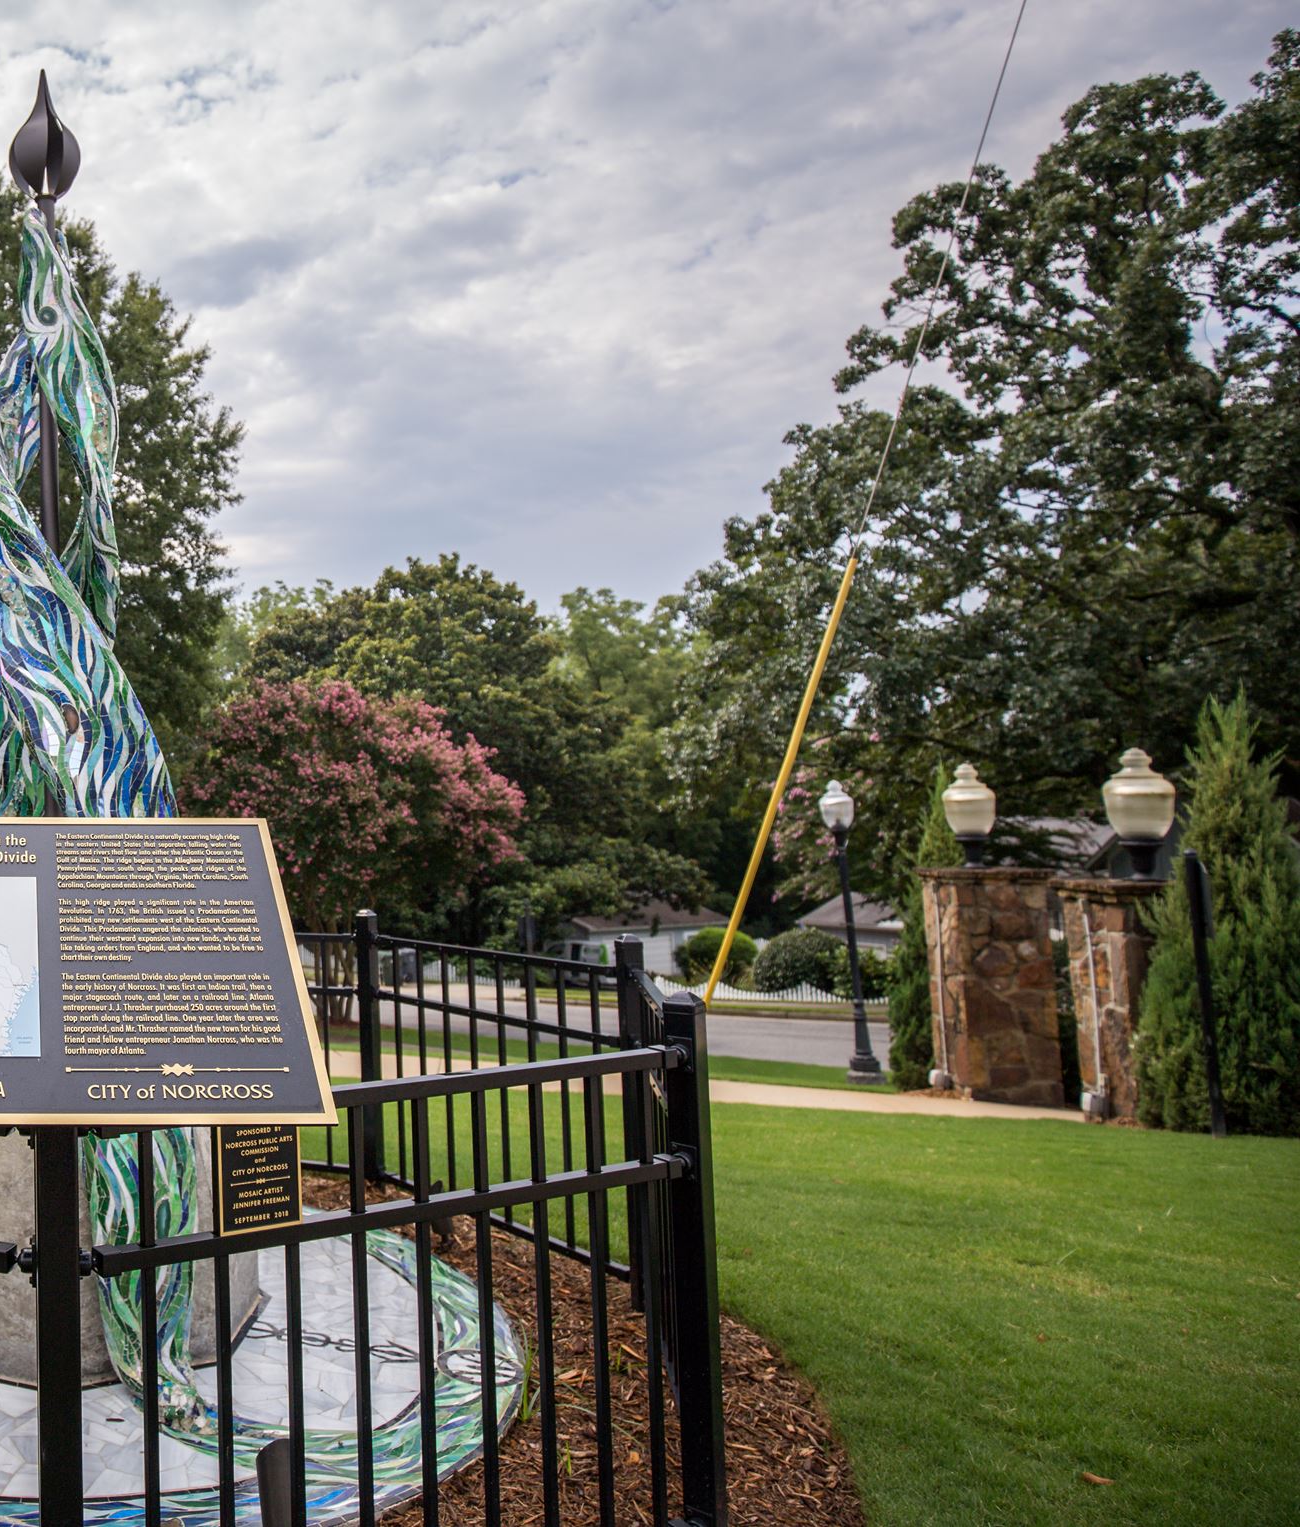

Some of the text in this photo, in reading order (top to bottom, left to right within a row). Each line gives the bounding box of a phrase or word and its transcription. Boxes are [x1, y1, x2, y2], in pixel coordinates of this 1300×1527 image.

[5, 834, 27, 846] the
[61, 944, 72, 952] like
[75, 944, 95, 954] taking
[98, 944, 117, 952] orders
[120, 944, 135, 952] from
[168, 944, 180, 952] and
[183, 944, 196, 952] who
[198, 944, 221, 952] wanted
[232, 944, 240, 952] be
[242, 944, 255, 952] free
[62, 973, 74, 981] The
[76, 973, 100, 981] Eastern
[102, 973, 139, 981] Continental
[142, 973, 162, 981] Divide
[165, 973, 178, 981] also
[180, 973, 201, 983] played
[214, 973, 246, 983] important
[248, 973, 261, 981] role
[263, 973, 269, 981] in
[62, 983, 72, 991] the
[75, 983, 91, 993] early
[94, 983, 116, 993] history
[119, 983, 125, 991] of
[128, 983, 158, 991] Norcross.
[160, 983, 165, 991] It
[182, 983, 195, 991] first
[208, 983, 229, 991] Indian
[232, 983, 248, 993] trail,
[250, 983, 265, 991] then
[63, 993, 82, 1003] major
[86, 993, 121, 1003] stagecoach
[125, 994, 144, 1003] route,
[148, 993, 160, 1001] and
[164, 993, 178, 1001] later
[202, 993, 228, 1001] railroad
[232, 993, 246, 1001] line.
[250, 993, 274, 1001] Atlanta
[63, 1005, 106, 1014] entrepreneur
[124, 1004, 152, 1012] Thrasher
[155, 1004, 189, 1014] purchased
[191, 1004, 204, 1012] 250
[224, 1004, 248, 1012] around
[250, 1004, 261, 1012] the
[263, 1004, 276, 1012] first
[64, 1015, 77, 1024] stop
[80, 1014, 98, 1022] north
[101, 1014, 120, 1024] along
[123, 1014, 133, 1022] the
[136, 1014, 163, 1022] railroad
[165, 1014, 180, 1022] line.
[183, 1014, 196, 1022] One
[199, 1016, 213, 1024] year
[216, 1014, 231, 1022] later
[234, 1014, 245, 1022] the
[64, 1025, 109, 1035] incorporated,
[111, 1025, 124, 1033] and
[126, 1025, 136, 1033] Mr.
[138, 1025, 167, 1033] Thrasher
[170, 1025, 193, 1033] named
[195, 1025, 206, 1033] the
[241, 1025, 250, 1033] for
[252, 1025, 262, 1033] his
[264, 1025, 280, 1035] good
[65, 1036, 85, 1044] friend
[87, 1036, 100, 1044] and
[103, 1036, 123, 1044] fellow
[126, 1037, 170, 1046] entrepreneur
[173, 1036, 205, 1044] Jonathan
[207, 1036, 238, 1046] Norcross,
[240, 1036, 254, 1044] who
[272, 1036, 283, 1044] the
[65, 1047, 146, 1057] fourth mayor of Atlanta.
[87, 1084, 274, 1100] CITY of NORCROSS
[236, 1127, 271, 1136] SPONSORED
[225, 1139, 257, 1149] NORCROSS
[258, 1137, 278, 1145] PUBLIC
[240, 1146, 279, 1156] COMMISSION
[232, 1169, 246, 1177] CITY
[256, 1163, 288, 1173] NORCROSS
[238, 1186, 283, 1198] MOSAIC ARTIST
[232, 1196, 290, 1210] JENNIFER FREEMAN
[234, 1214, 270, 1224] SEPTEMBER
